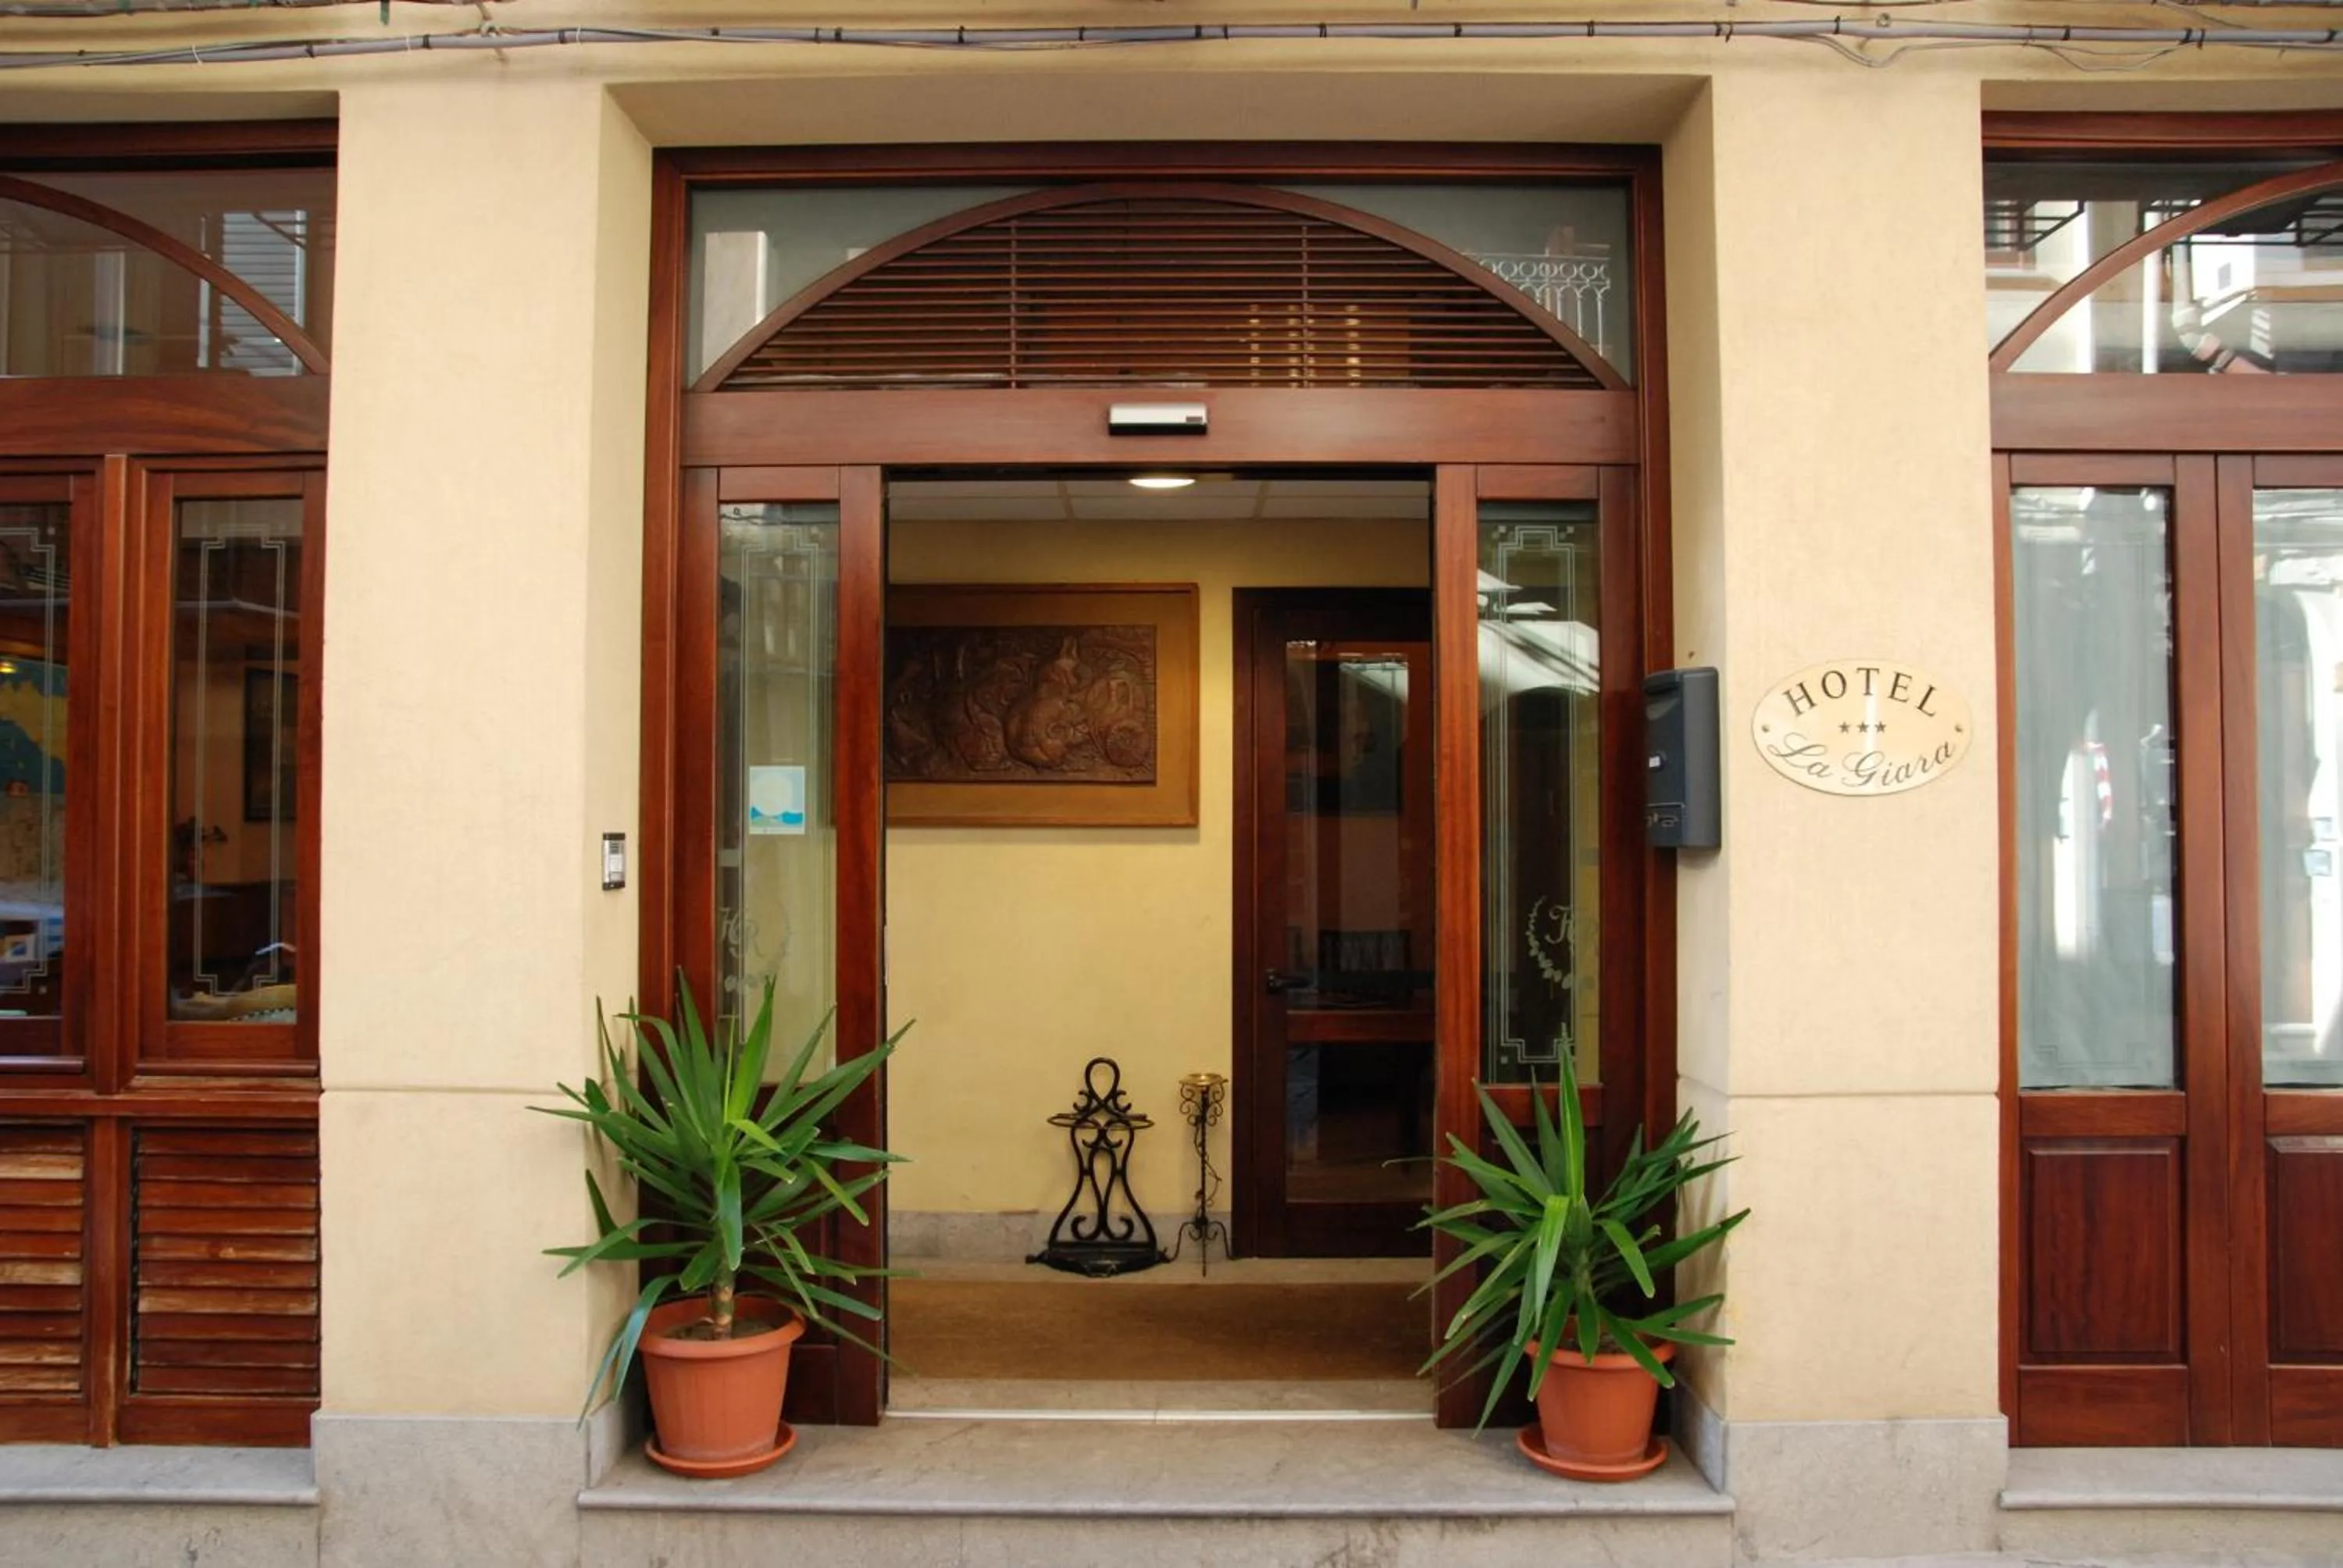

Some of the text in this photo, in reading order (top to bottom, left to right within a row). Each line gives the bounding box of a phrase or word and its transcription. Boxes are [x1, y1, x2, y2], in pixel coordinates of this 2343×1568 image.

[1781, 667, 1938, 717] HOTEL
[1766, 732, 1954, 787] La Giara
